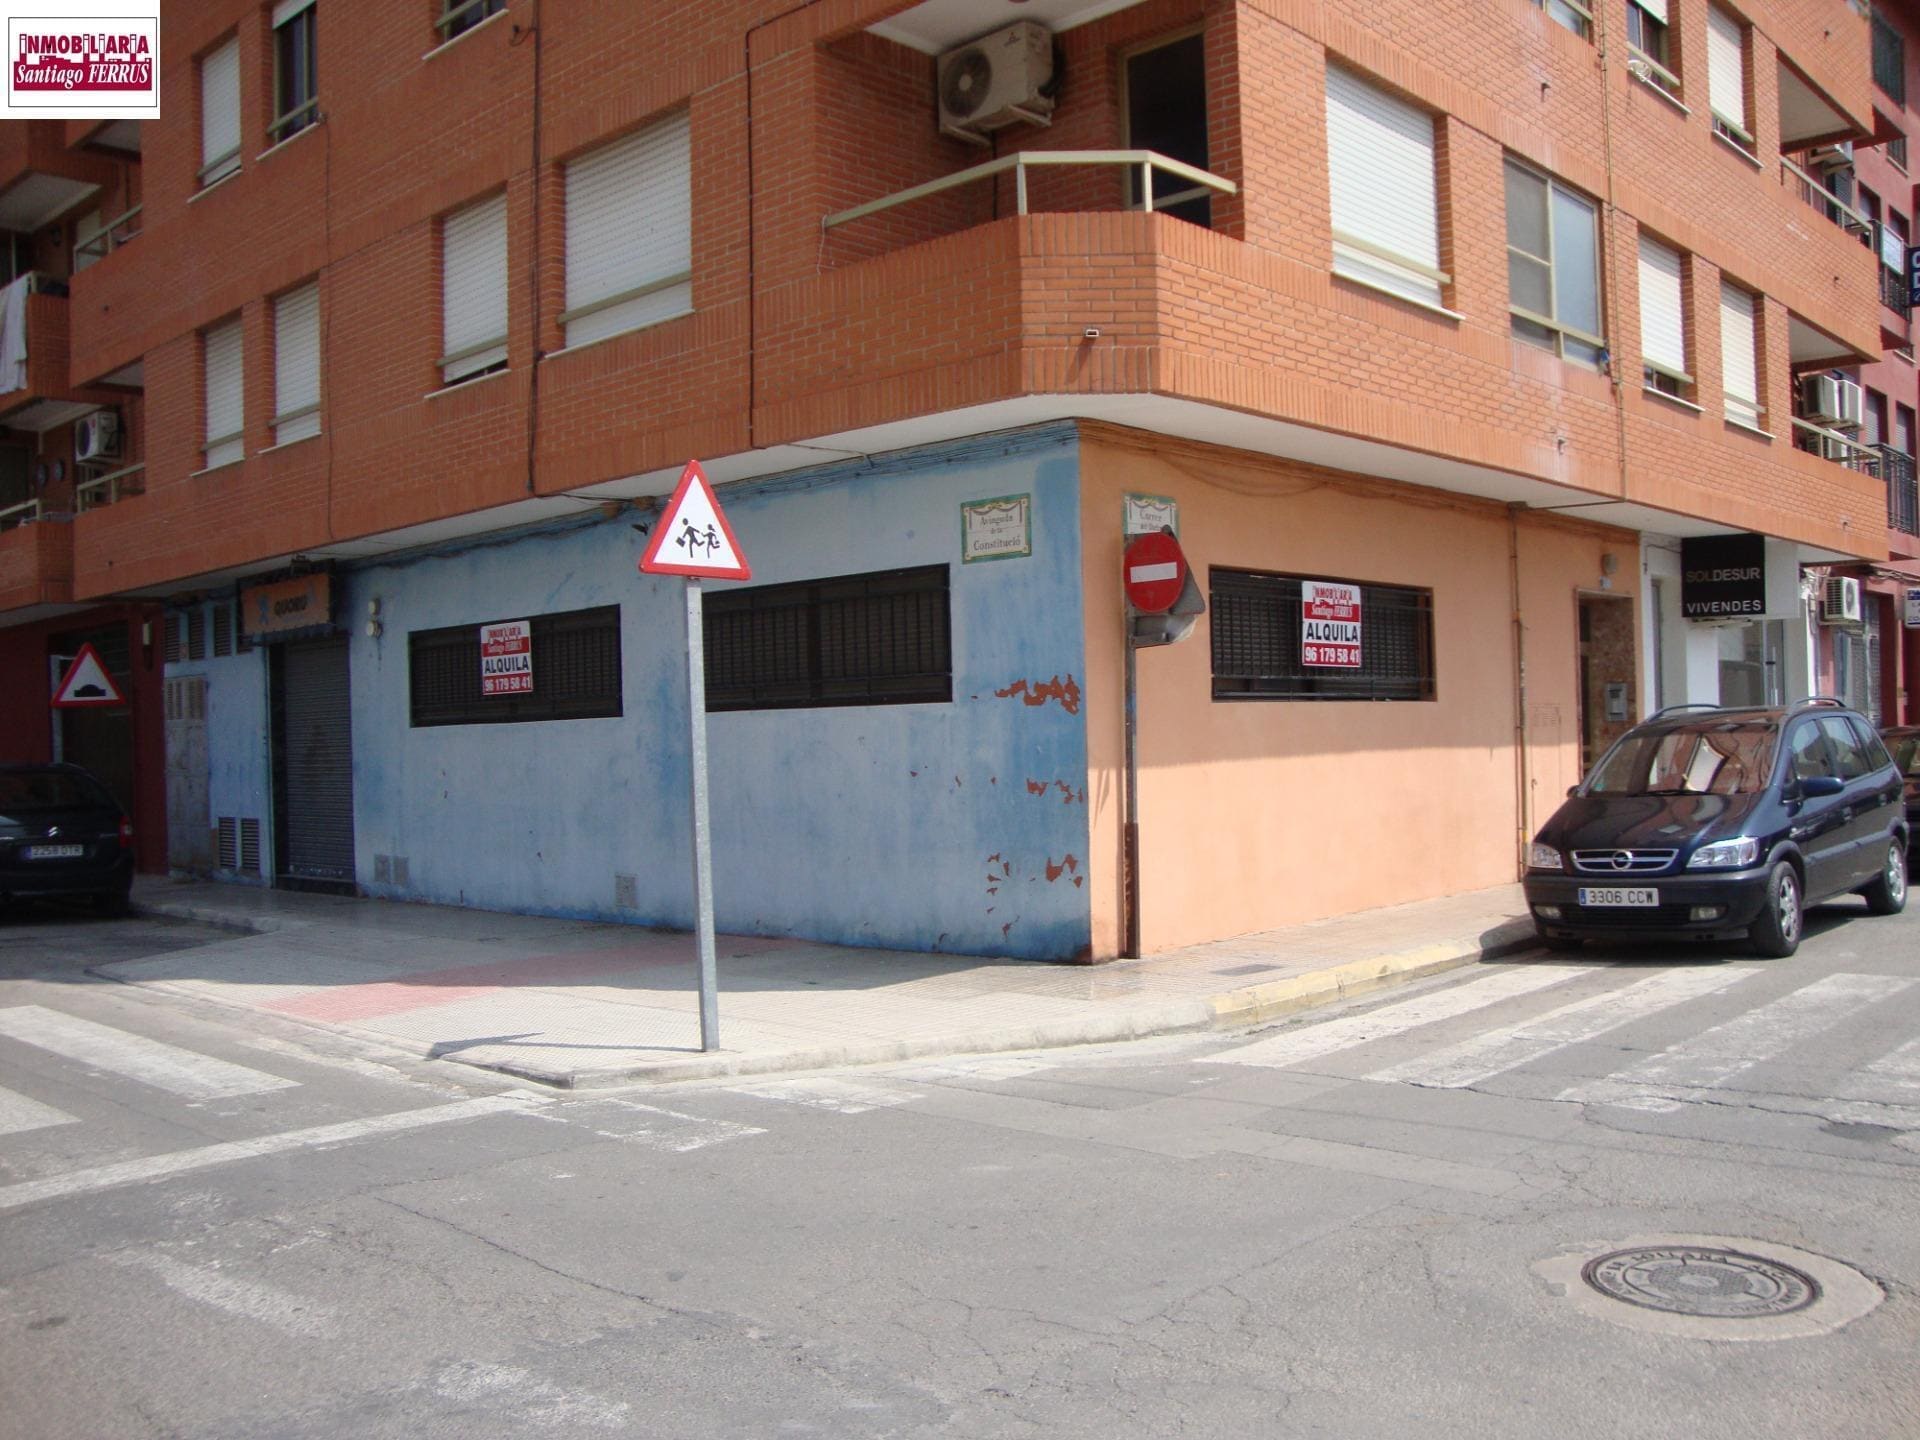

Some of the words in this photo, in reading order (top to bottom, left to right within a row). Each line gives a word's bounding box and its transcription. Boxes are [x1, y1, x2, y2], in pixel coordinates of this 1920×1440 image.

[973, 535, 1021, 551] Constitució
[1686, 567, 1761, 583] SOLDESUR
[1687, 600, 1761, 613] VIVENDES
[1306, 622, 1358, 642] ALQUILA
[1305, 646, 1317, 662] 96
[1319, 647, 1336, 663] 179
[1336, 648, 1348, 663] 58
[1349, 648, 1360, 663] 41
[485, 656, 529, 673] ALQUILA
[496, 677, 509, 690] 179
[521, 675, 531, 689] 41
[1589, 890, 1622, 904] 3306
[1628, 890, 1653, 904] CCW
